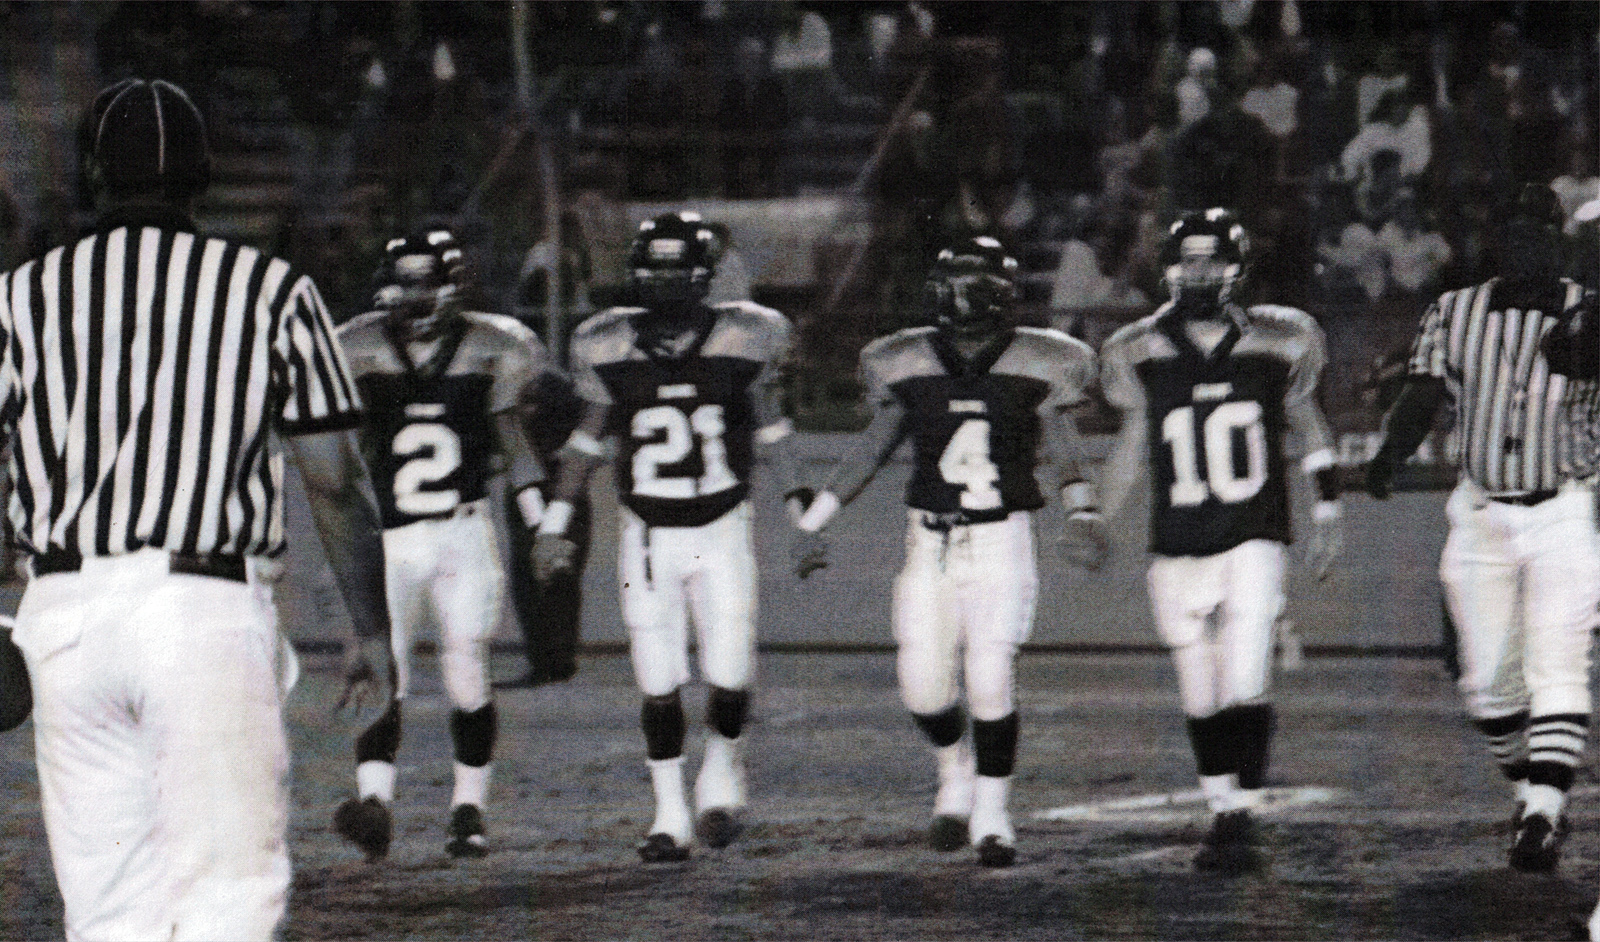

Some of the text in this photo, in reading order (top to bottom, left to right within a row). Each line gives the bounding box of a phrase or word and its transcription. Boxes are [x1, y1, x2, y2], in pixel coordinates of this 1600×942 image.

[393, 424, 461, 513] 2
[632, 405, 737, 499] 21
[939, 420, 1001, 510] 4
[1163, 401, 1267, 505] 10
